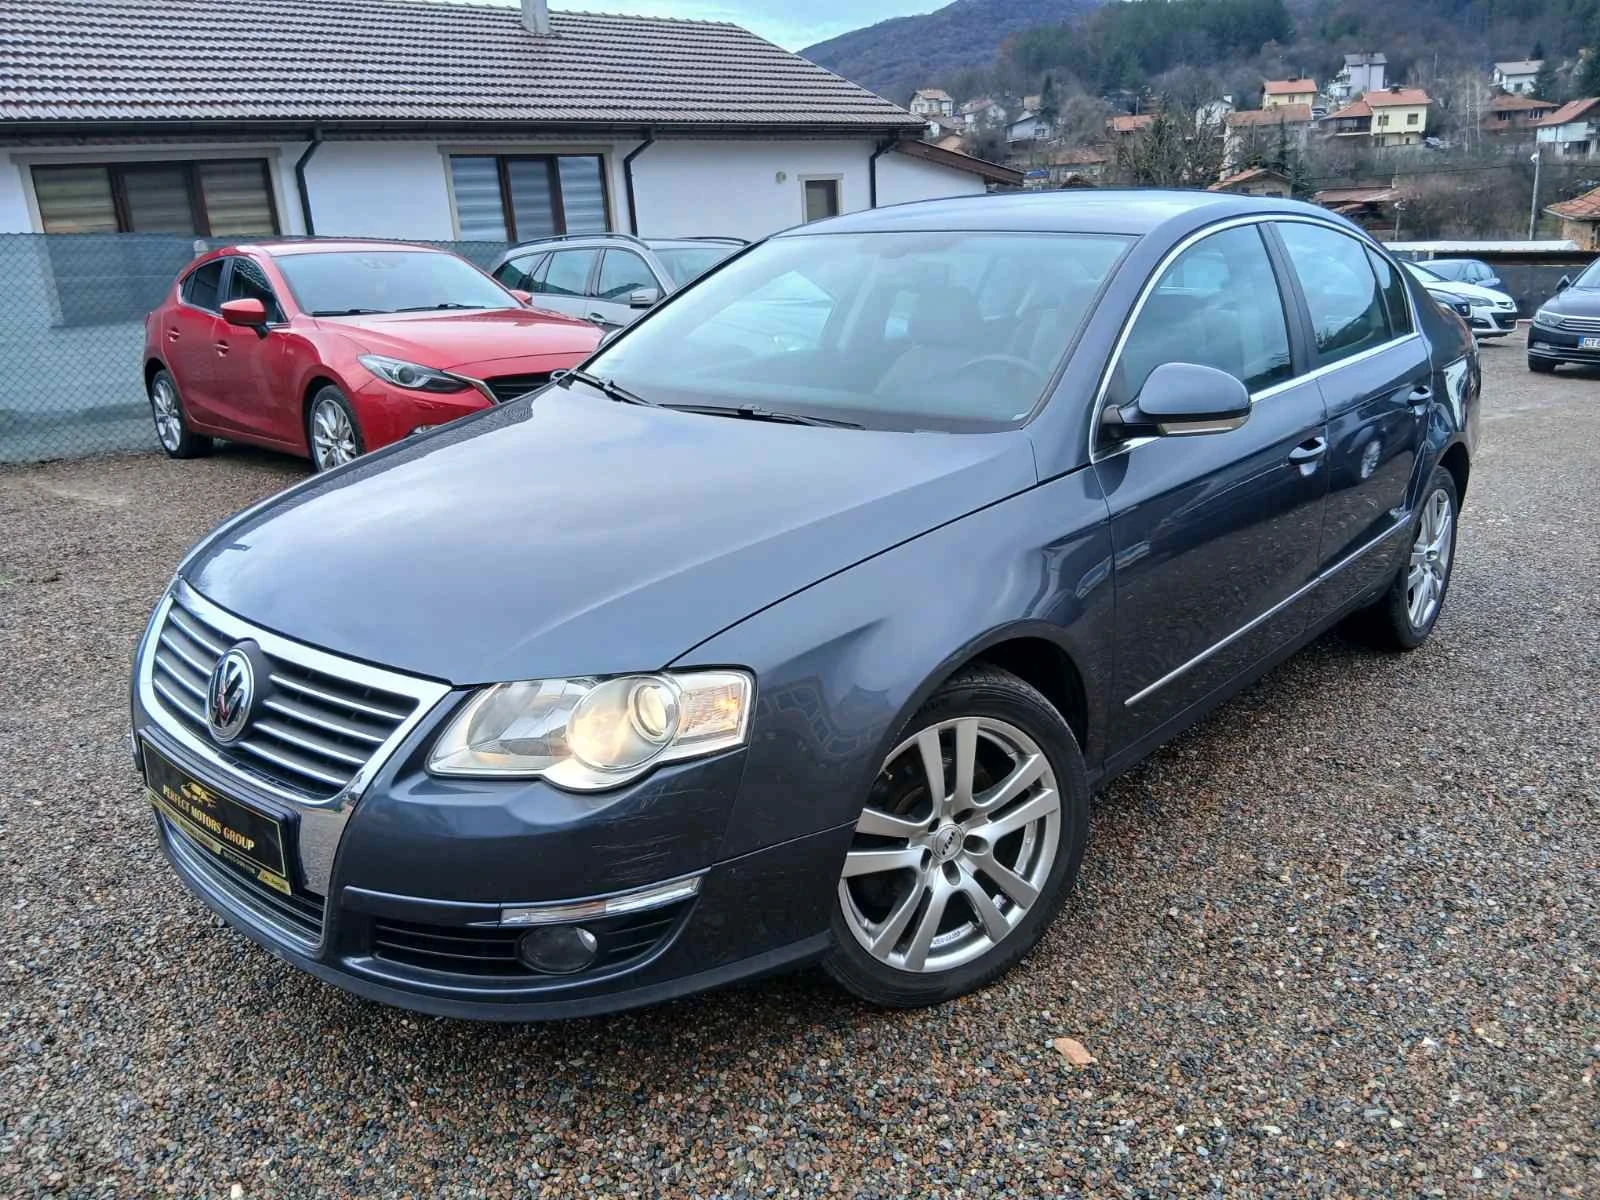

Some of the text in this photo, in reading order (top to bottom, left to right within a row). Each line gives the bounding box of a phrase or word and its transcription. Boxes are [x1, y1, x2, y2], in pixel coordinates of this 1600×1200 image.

[163, 784, 255, 851] PERFECT MOTORS GROUP
